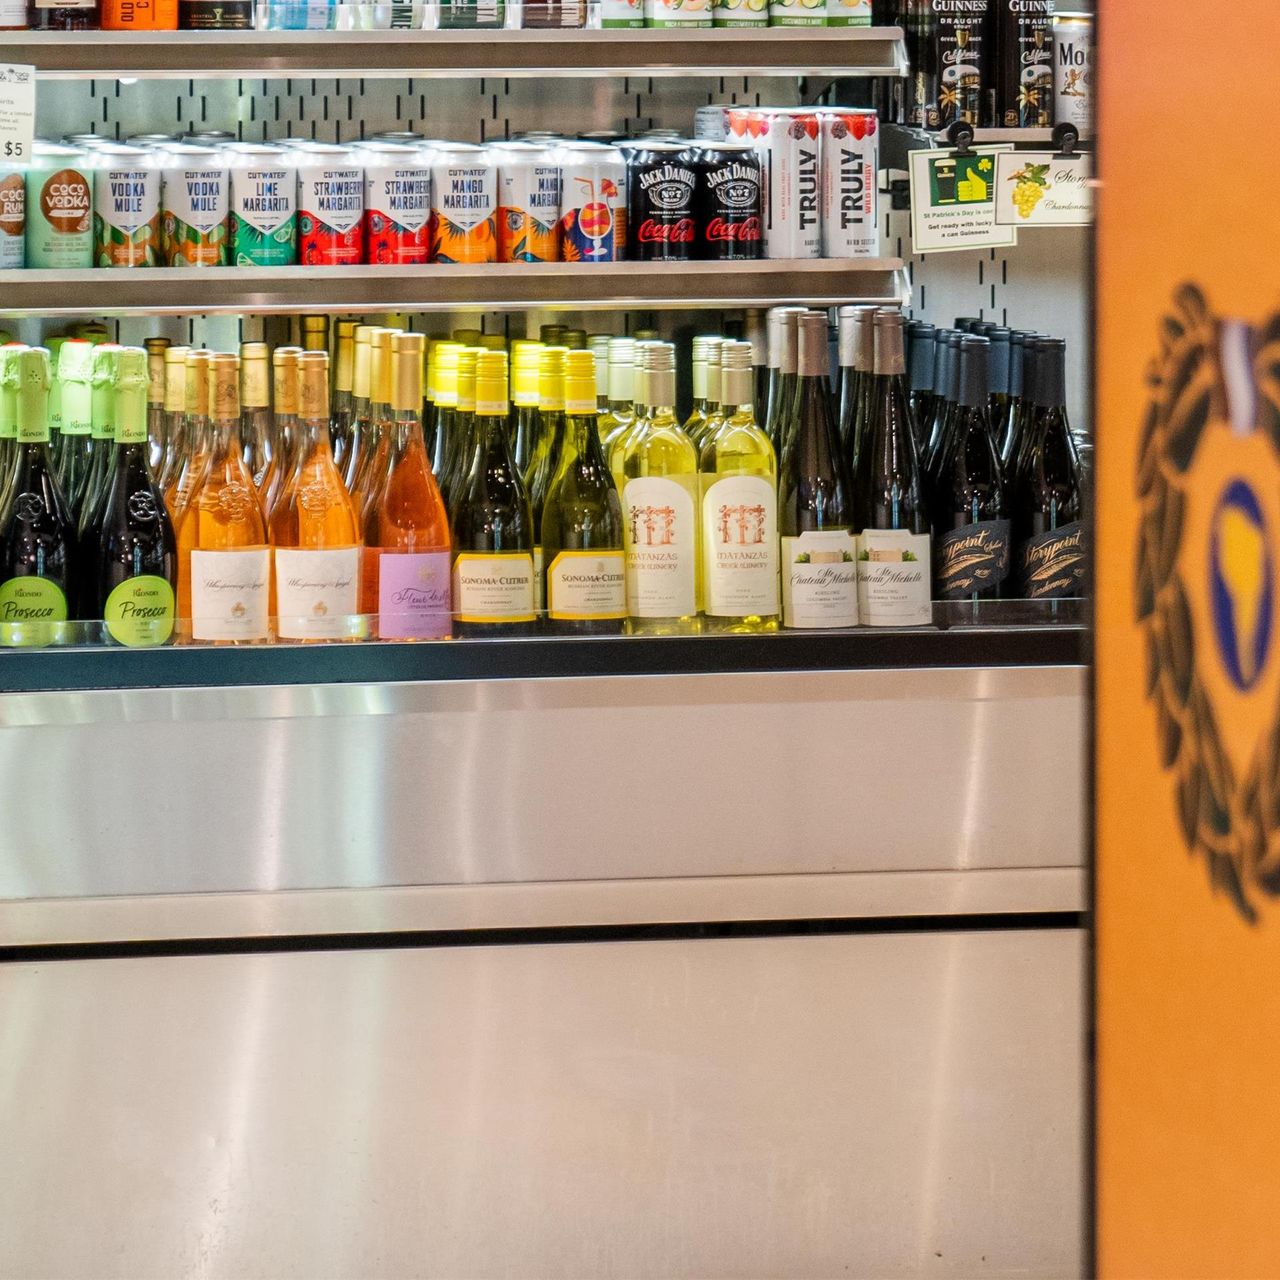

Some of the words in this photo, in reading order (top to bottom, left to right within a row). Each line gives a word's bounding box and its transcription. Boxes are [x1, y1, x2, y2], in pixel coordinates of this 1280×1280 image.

[121, 1, 134, 23] OLD
[940, 17, 983, 25] DRAUGHT
[4, 140, 23, 157] $5
[109, 172, 147, 180] CUTWATER
[185, 171, 222, 179] CUTWATER
[248, 172, 286, 180] CUTWATER
[323, 171, 359, 179] CUTWATER
[448, 169, 487, 177] CUTWATER
[639, 169, 665, 190] JACK
[706, 168, 732, 189] JACK
[49, 183, 85, 195] COCO
[111, 182, 145, 196] VODKA
[187, 181, 220, 196] VODKA
[256, 182, 278, 196] LIME
[452, 179, 483, 194] MANGO
[799, 148, 817, 231] TRULY
[840, 148, 864, 230] TRULY
[45, 194, 89, 208] VODKA
[115, 198, 142, 212] MULE
[191, 198, 217, 211] MULE
[243, 197, 289, 211] MARGARITA
[389, 195, 429, 210] MARGARIT
[443, 194, 489, 209] MARGARITA
[1044, 200, 1089, 211] Chardonna
[962, 209, 974, 218] Day
[927, 223, 940, 231] Get
[942, 222, 958, 232] ready
[960, 221, 973, 229] with
[975, 220, 992, 229] lucky
[960, 228, 989, 237] Guinness
[2, 600, 54, 619] Prosecco
[119, 600, 168, 619] Prosecco
